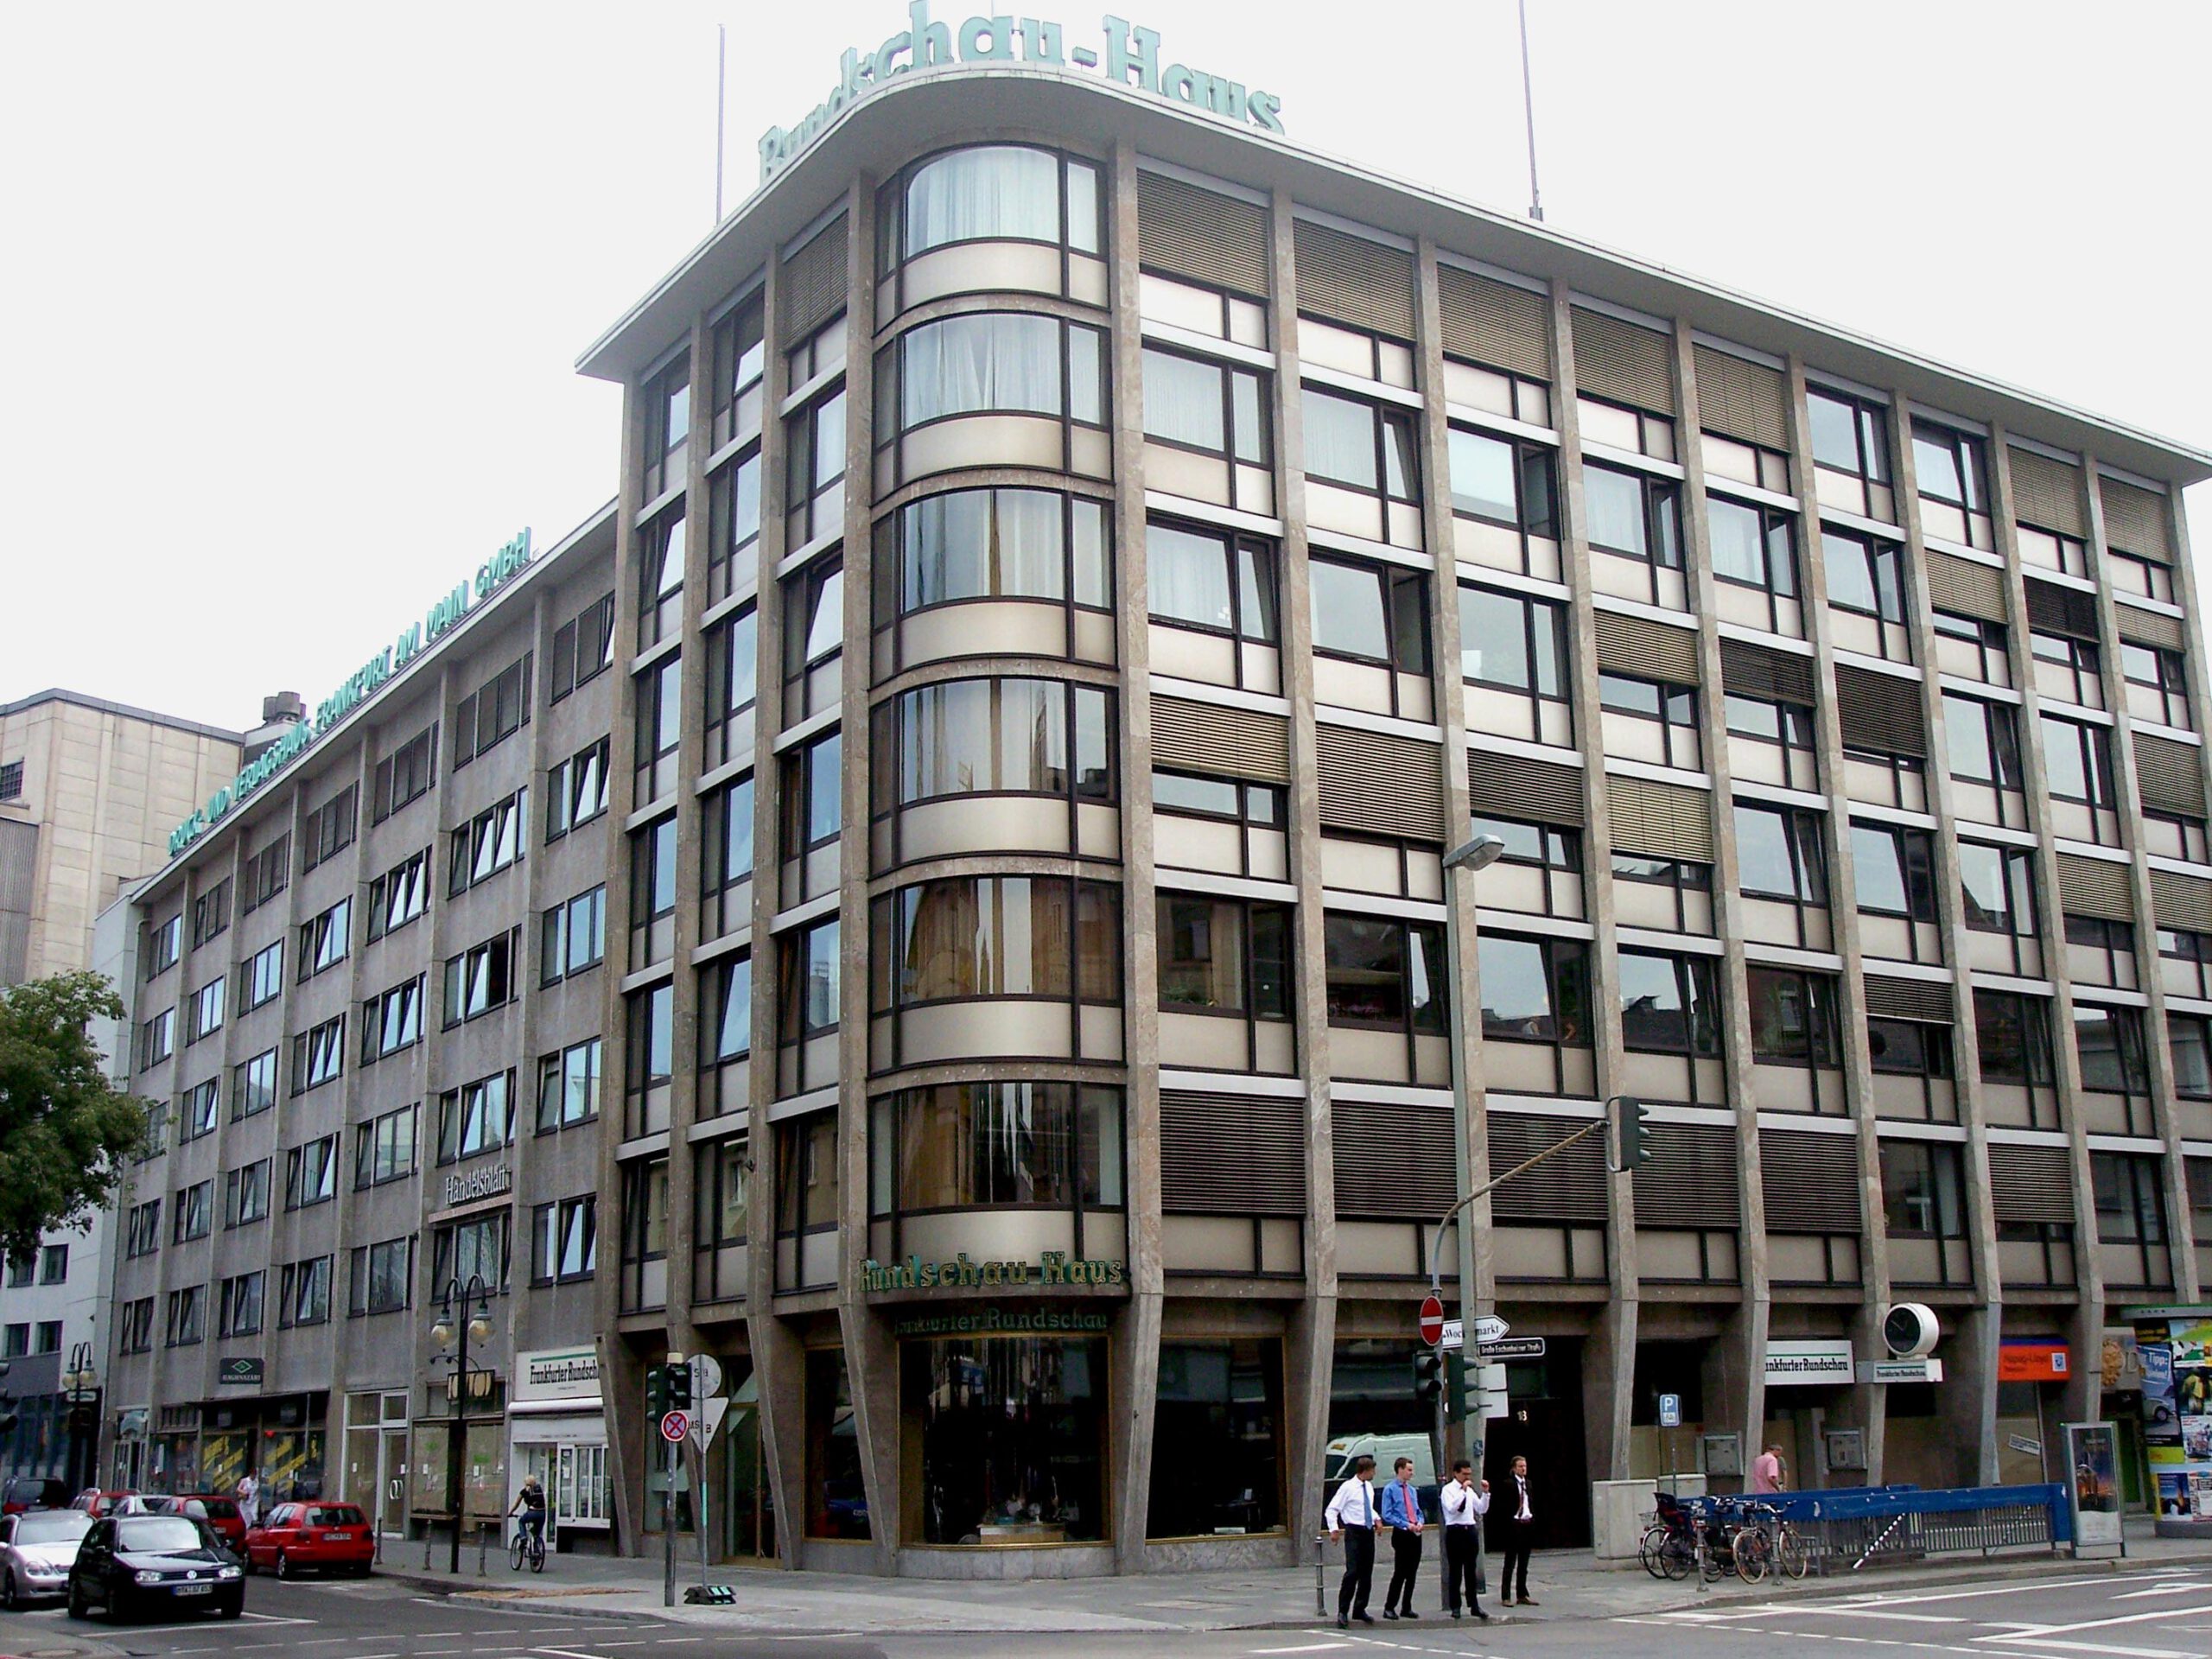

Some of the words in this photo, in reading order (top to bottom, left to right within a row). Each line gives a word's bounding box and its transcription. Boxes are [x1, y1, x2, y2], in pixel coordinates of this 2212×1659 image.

[758, 0, 1286, 187] Rundschau-Haus
[315, 645, 393, 734] FRANKFURT
[394, 620, 421, 669] AM
[426, 579, 469, 643] MAIN
[474, 525, 531, 599] GMBH
[446, 1164, 506, 1205] Handelsblatt
[859, 1252, 1028, 1292] Rundschau
[1041, 1250, 1122, 1285] Haus
[983, 1306, 1109, 1330] Rundschau
[530, 1363, 569, 1385] Frankfurter
[1803, 1357, 1848, 1372] Rundschau
[1664, 1396, 1674, 1412] P
